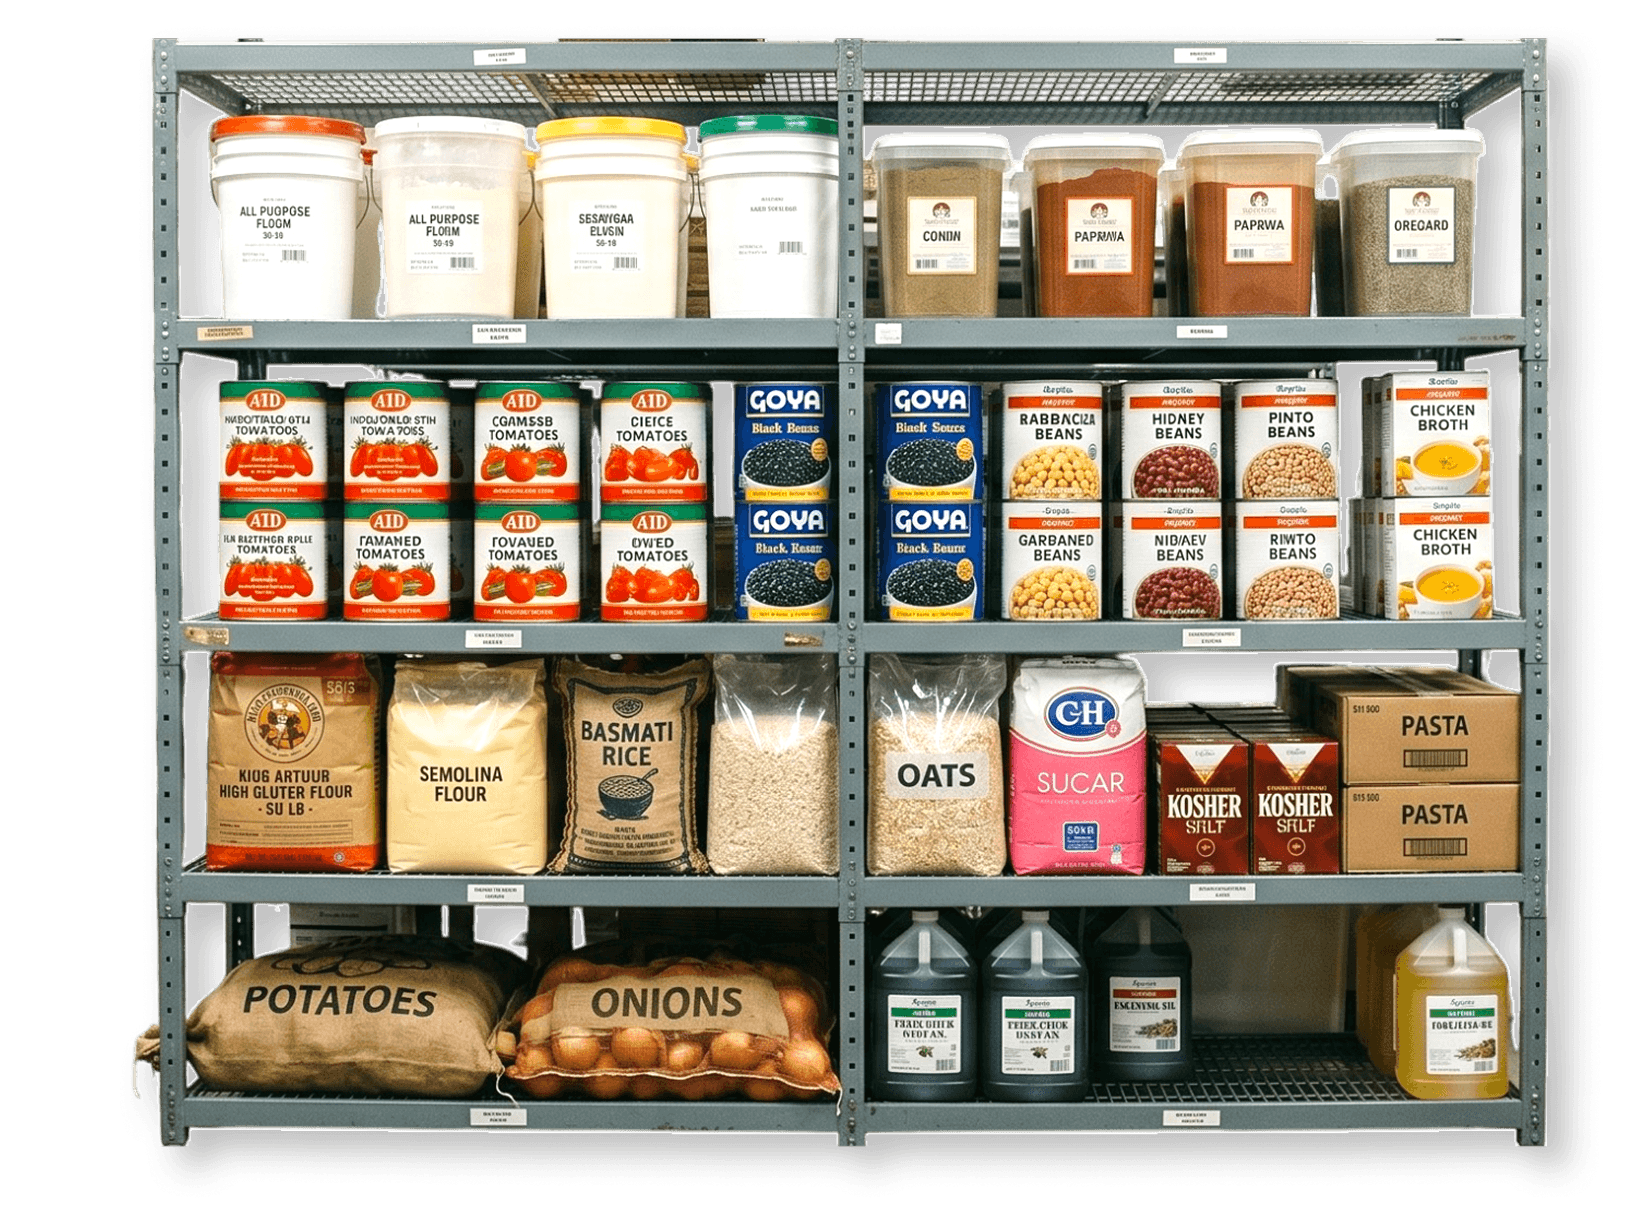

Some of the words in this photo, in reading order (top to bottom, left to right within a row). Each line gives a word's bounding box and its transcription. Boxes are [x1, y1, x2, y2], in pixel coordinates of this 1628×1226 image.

[240, 206, 257, 216] ALL
[409, 214, 426, 224] ALL
[430, 214, 479, 224] PURPOSE
[506, 394, 536, 408] AID
[636, 394, 666, 408] AID
[750, 390, 820, 413] GOYA
[895, 390, 966, 412] GOYA
[1410, 404, 1474, 416] CHICKEN
[1153, 414, 1204, 424] HIDNEY
[1269, 412, 1313, 423] PINTO
[1268, 427, 1315, 437] BEANS
[1419, 420, 1468, 431] BROTH
[490, 430, 558, 440] TOMATOES
[617, 431, 687, 441] TOMATOES
[1035, 429, 1082, 440] BEANS
[1156, 428, 1202, 439] BEANS
[506, 515, 536, 529] AID
[636, 515, 667, 530] AID
[754, 510, 824, 533] GOYA
[895, 510, 966, 533] GOYA
[1414, 529, 1477, 540] CHICKEN
[356, 548, 425, 559] TOMATOES
[489, 550, 557, 561] TOMATOES
[617, 551, 688, 561] TOMATOES
[1034, 550, 1080, 561] BEANS
[1157, 550, 1203, 561] BEANS
[1269, 548, 1316, 559] BEANS
[1422, 544, 1471, 555] BROTH
[582, 721, 673, 742] BASMATI
[1402, 716, 1468, 736] PASTA
[602, 747, 651, 766] RICE
[420, 766, 503, 782] SEMOLINA
[898, 763, 975, 787] OATS
[220, 785, 248, 798] HIGH
[310, 785, 352, 798] FLOUR
[435, 787, 486, 801] FLOUR
[1168, 795, 1242, 818] KOSHER
[1259, 794, 1333, 817] KOSHER
[1402, 804, 1468, 824] PASTA
[243, 985, 437, 1017] POTATOES
[591, 987, 742, 1019] ONIONS
